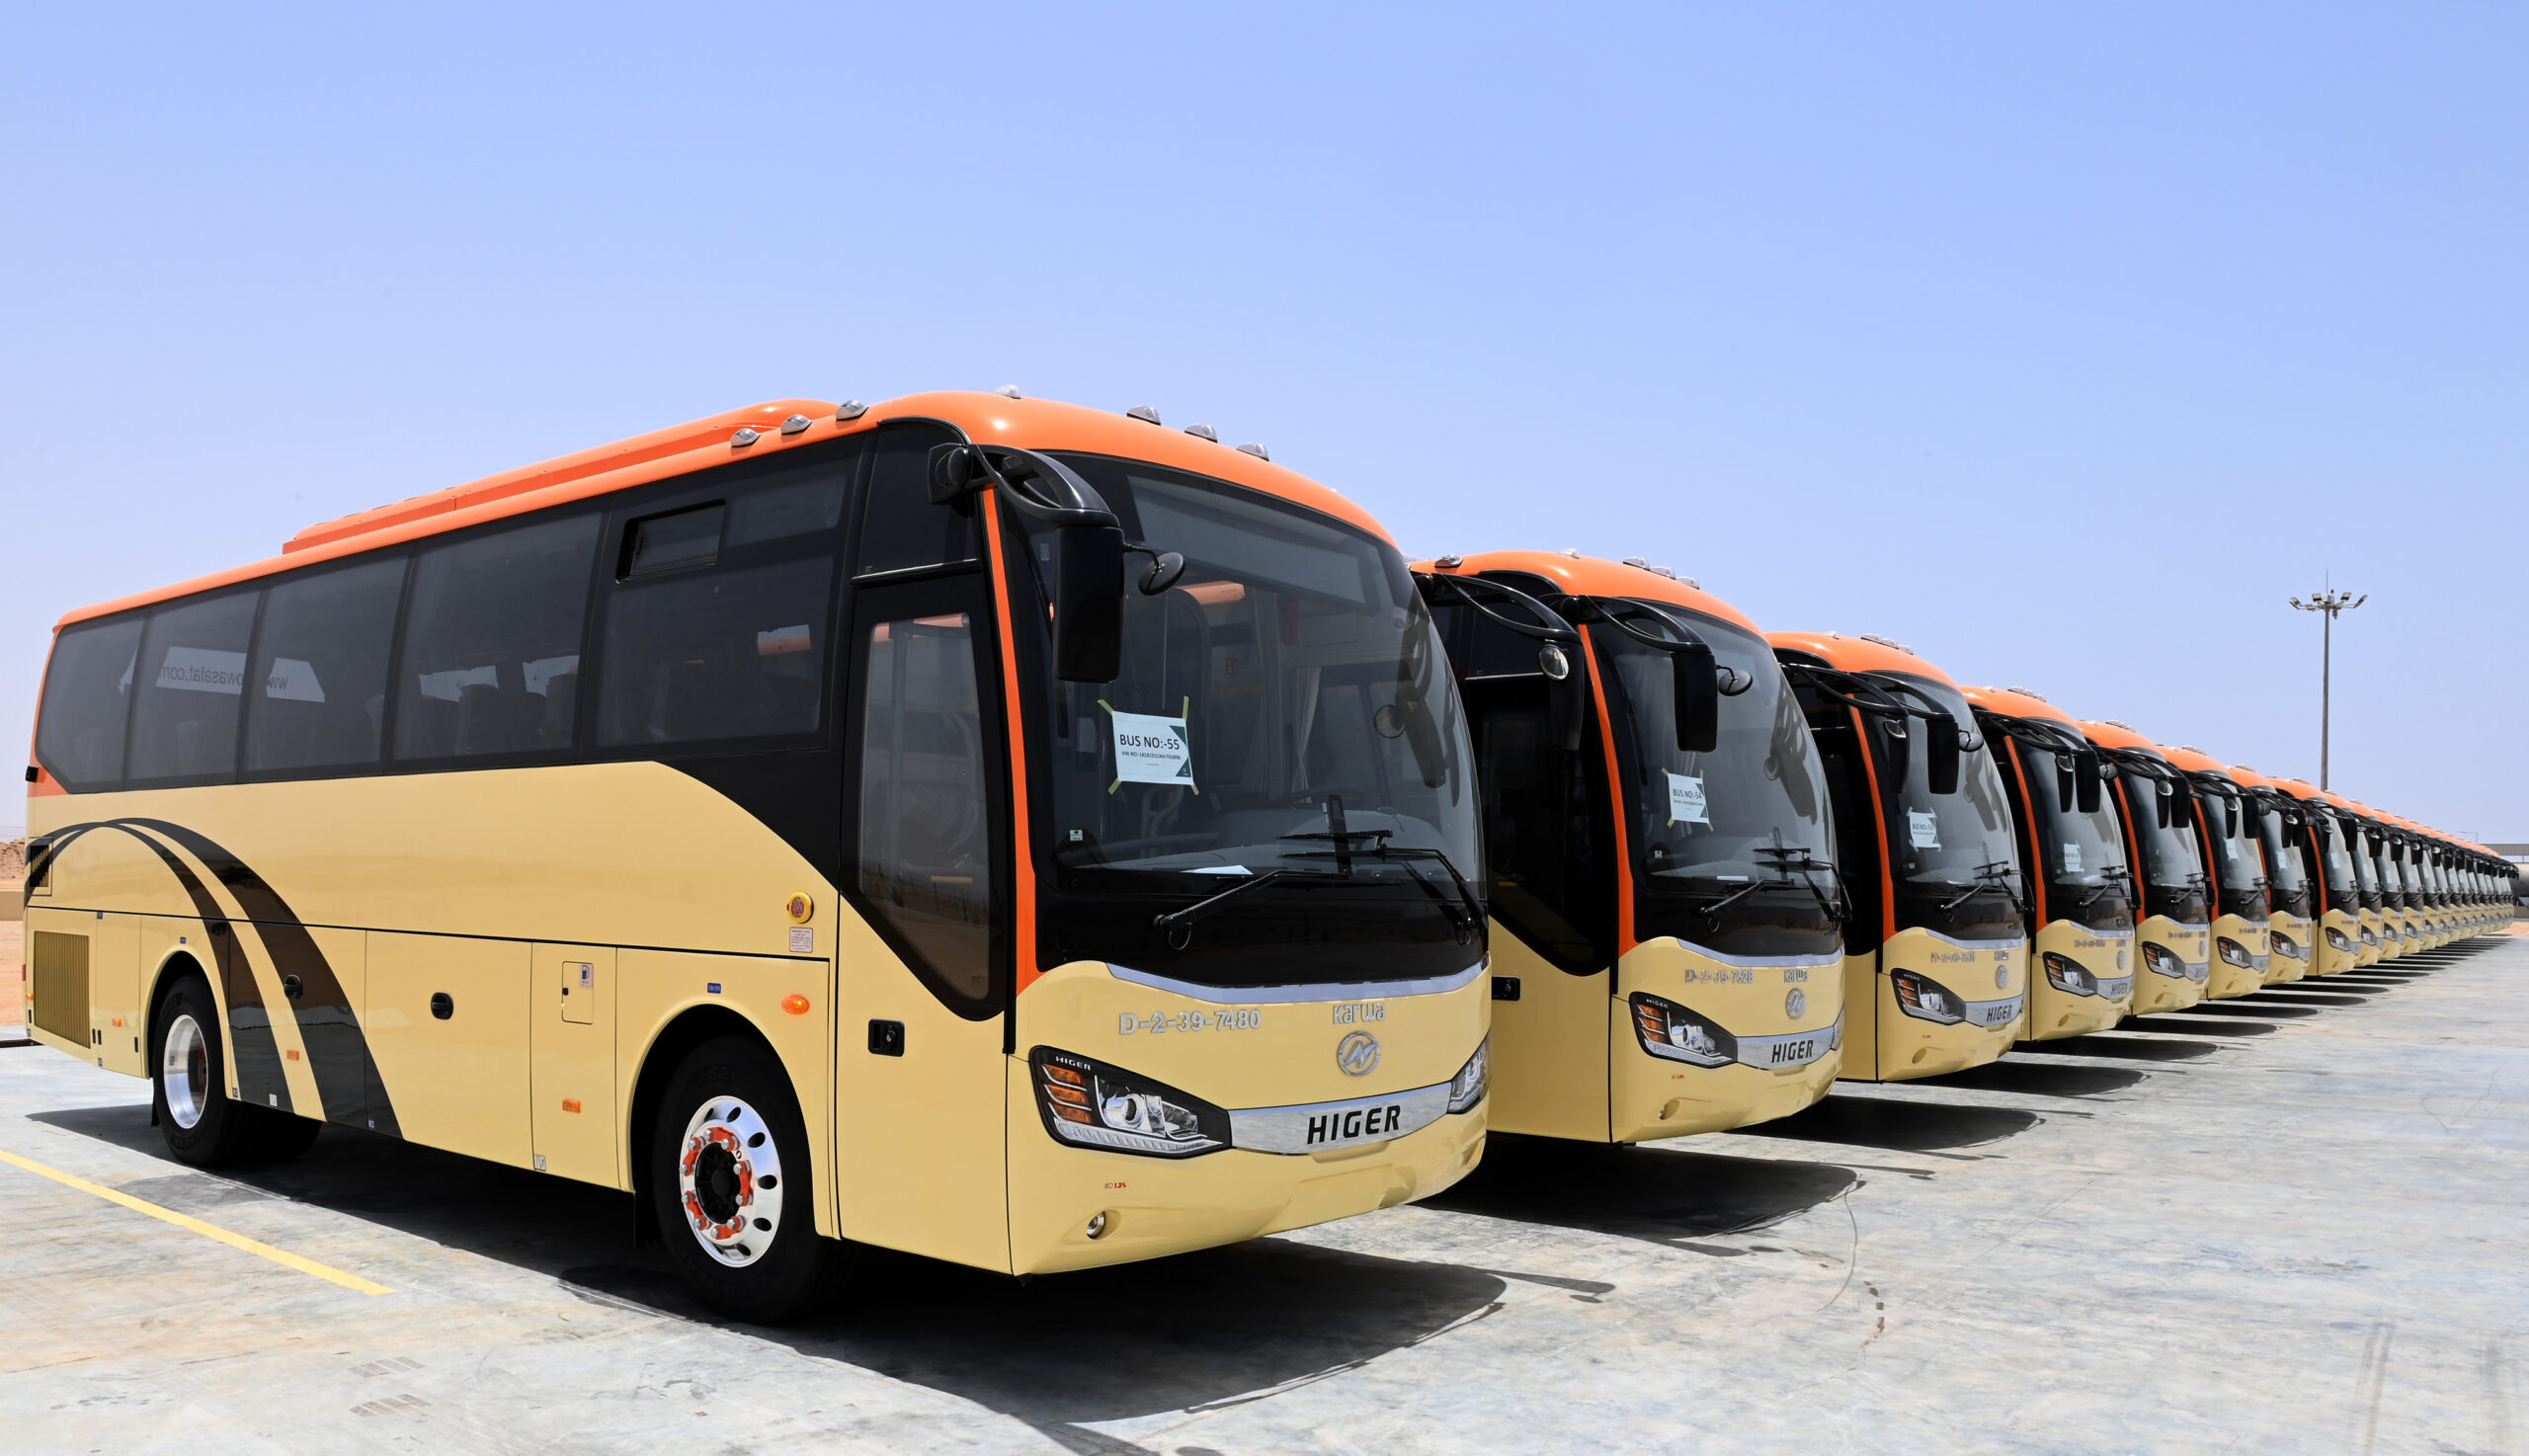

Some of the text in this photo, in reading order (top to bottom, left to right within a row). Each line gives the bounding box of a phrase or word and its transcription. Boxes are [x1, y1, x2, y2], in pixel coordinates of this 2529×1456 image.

[1119, 734, 1180, 751] BUS NO:-55
[1672, 788, 1683, 797] BUS
[1646, 998, 1669, 1009] HIGER
[1119, 1009, 1262, 1035] D-2-39-7480
[1986, 1005, 2012, 1022] HIGER
[1770, 1039, 1814, 1064] HIGER
[1055, 1056, 1092, 1071] HIGER
[1307, 1105, 1401, 1144] HIGER
